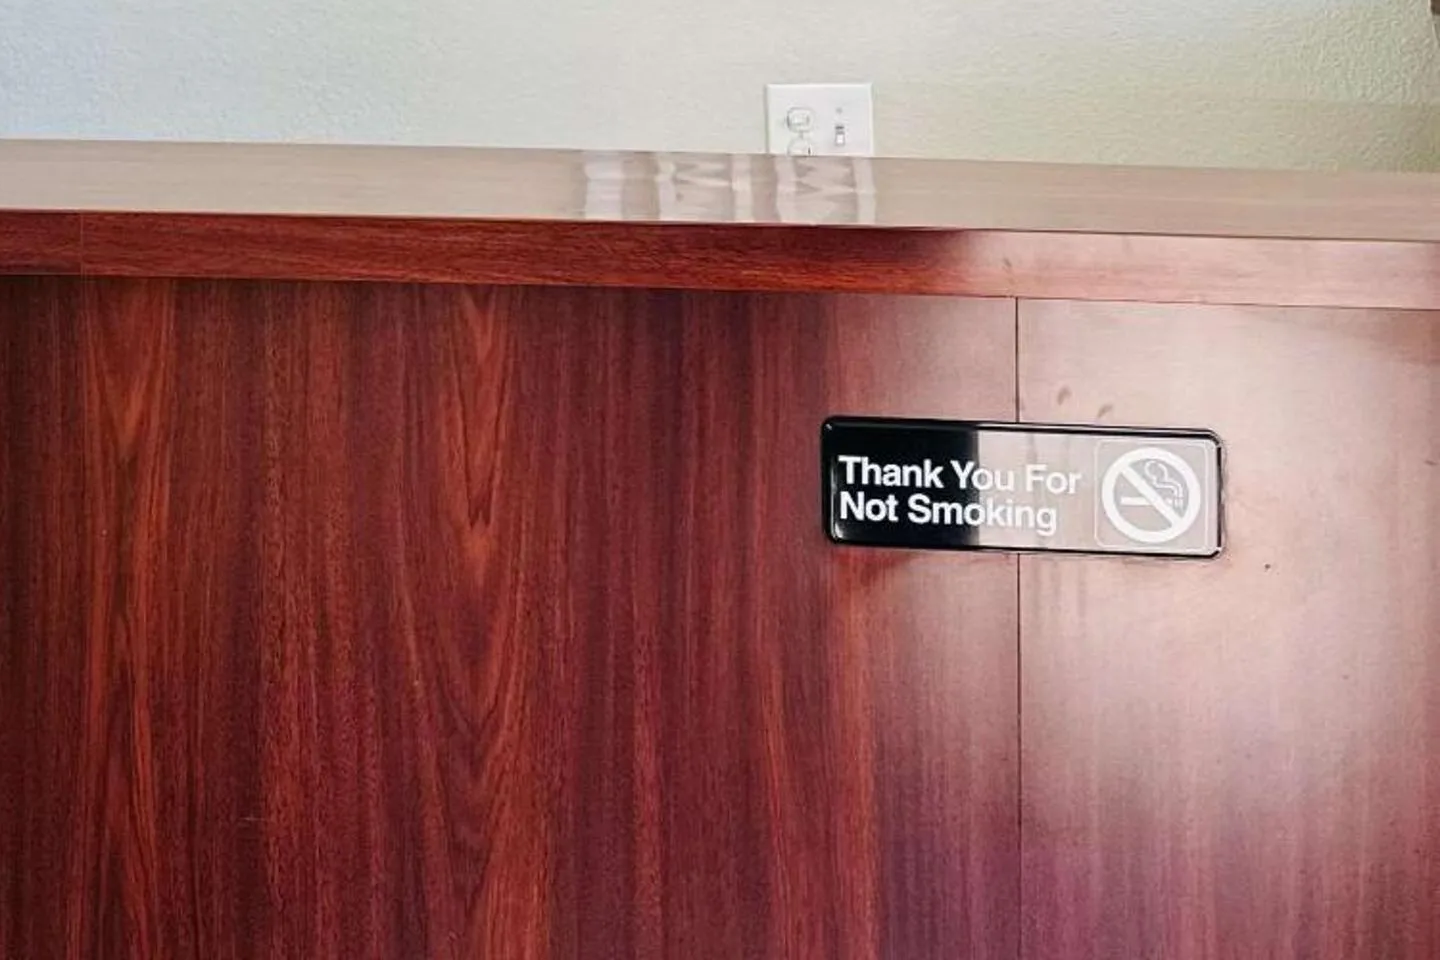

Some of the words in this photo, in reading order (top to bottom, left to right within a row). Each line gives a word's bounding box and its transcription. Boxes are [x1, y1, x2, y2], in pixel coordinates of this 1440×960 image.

[837, 454, 944, 489] Thank
[951, 459, 1016, 492] You
[1024, 464, 1082, 495] For
[839, 490, 900, 523] Not
[907, 494, 1058, 538] Smoking
